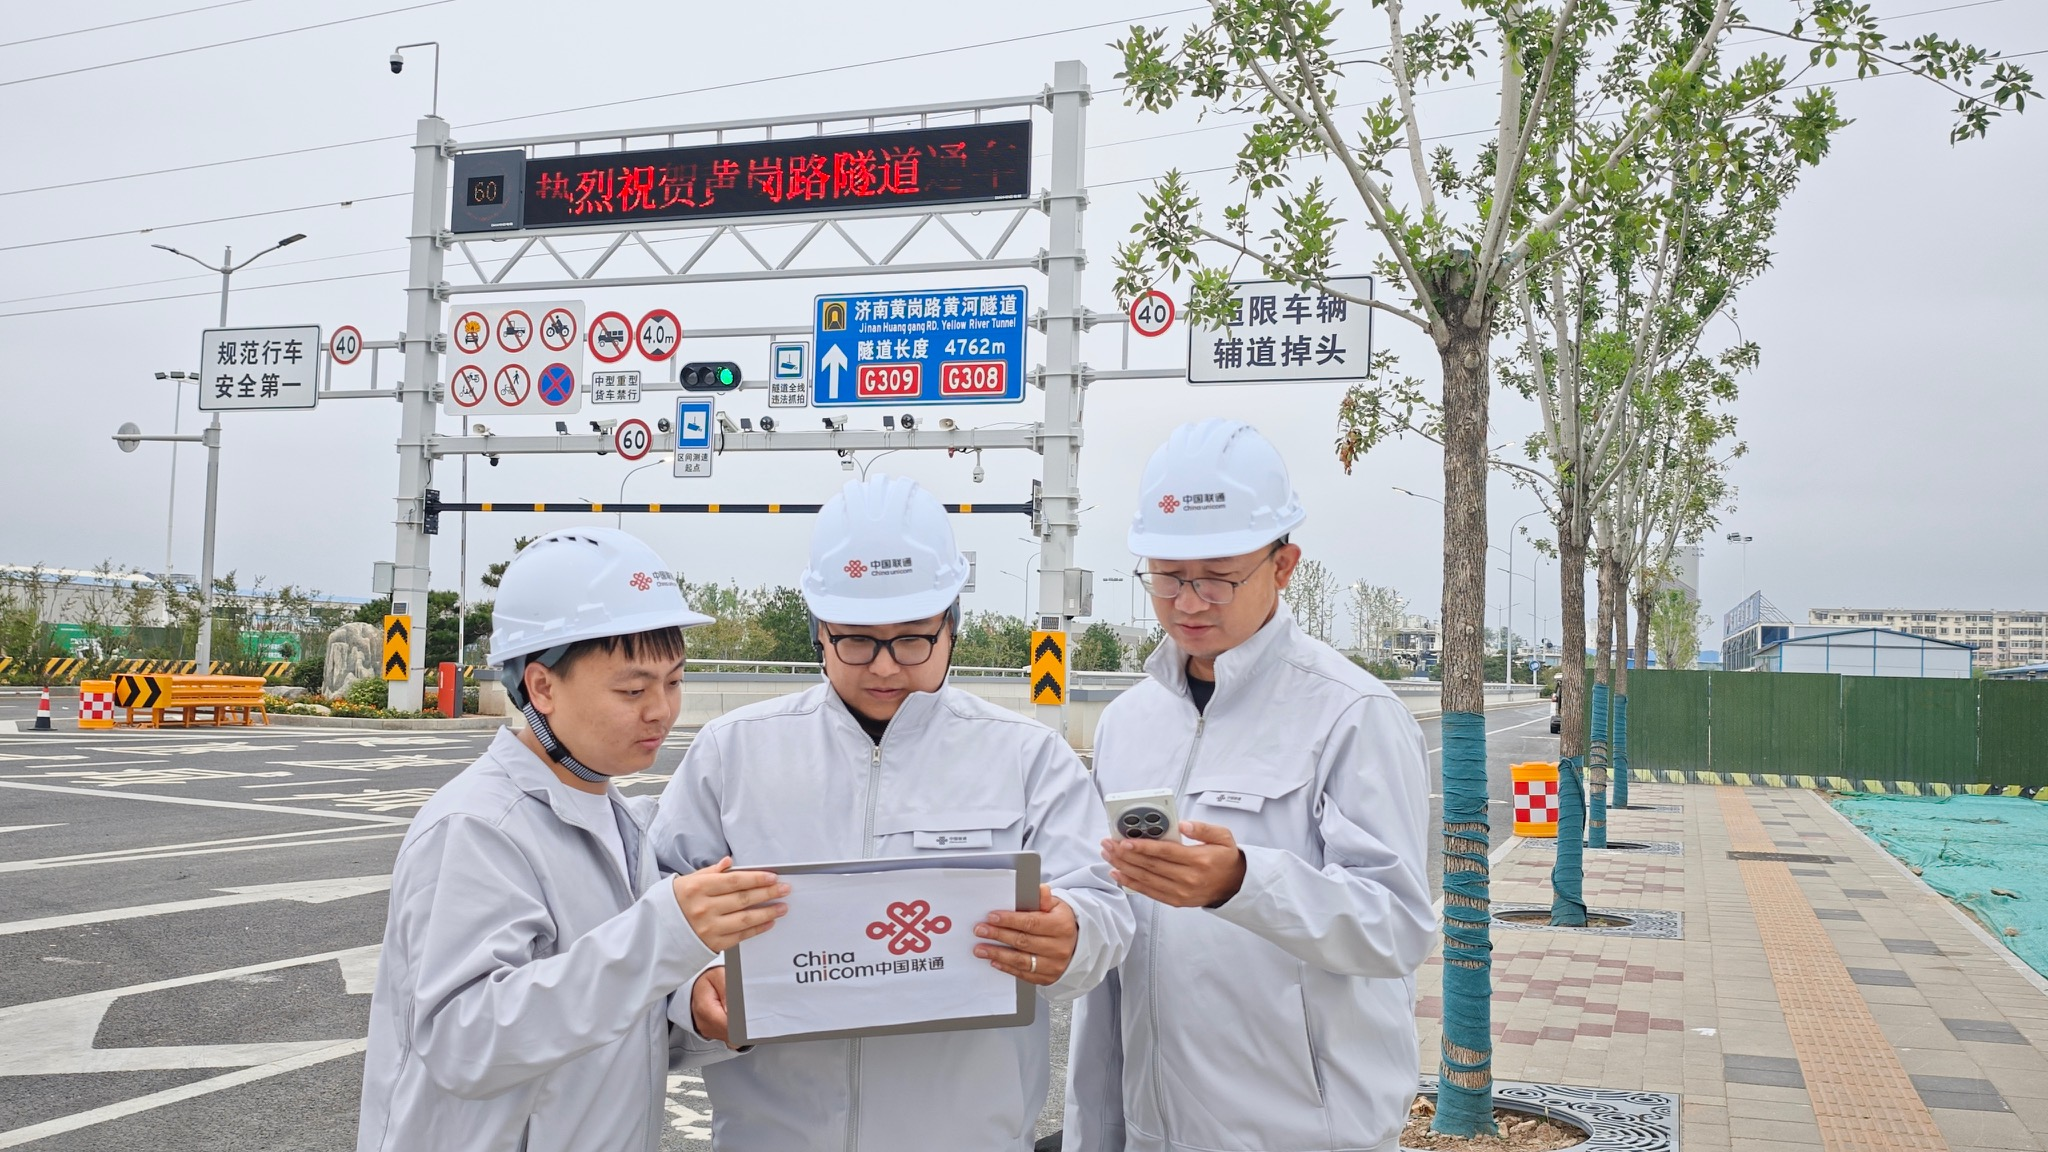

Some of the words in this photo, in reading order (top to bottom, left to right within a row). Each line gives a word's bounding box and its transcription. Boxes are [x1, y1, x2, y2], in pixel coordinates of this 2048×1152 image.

[474, 181, 497, 202] 60
[854, 294, 1018, 321] 济南黄岗路黄河隧道
[1138, 304, 1166, 324] 40
[859, 322, 882, 333] Jinan
[941, 319, 967, 331] Yellow
[969, 318, 990, 329] River
[991, 317, 1016, 329] Tunnel
[217, 339, 303, 366] 规范行车
[336, 335, 356, 354] 40
[857, 338, 929, 361] 隧道长度
[944, 338, 1006, 356] 4762m
[1213, 333, 1347, 369] 辅道掉头
[215, 373, 302, 399] 安全第一
[595, 374, 638, 387] 中型重型
[771, 382, 805, 393] 隧道全线
[865, 369, 914, 392] G309
[948, 366, 998, 390] G308
[595, 388, 638, 401] 货车禁行
[623, 430, 645, 450] 60
[677, 452, 708, 462] 区间测速
[685, 463, 701, 473] 起点
[1182, 492, 1225, 504] 中国联通
[870, 557, 912, 569] 中国联通
[793, 951, 855, 968] China
[795, 963, 875, 984] unicom
[875, 956, 945, 976] 中国联通
